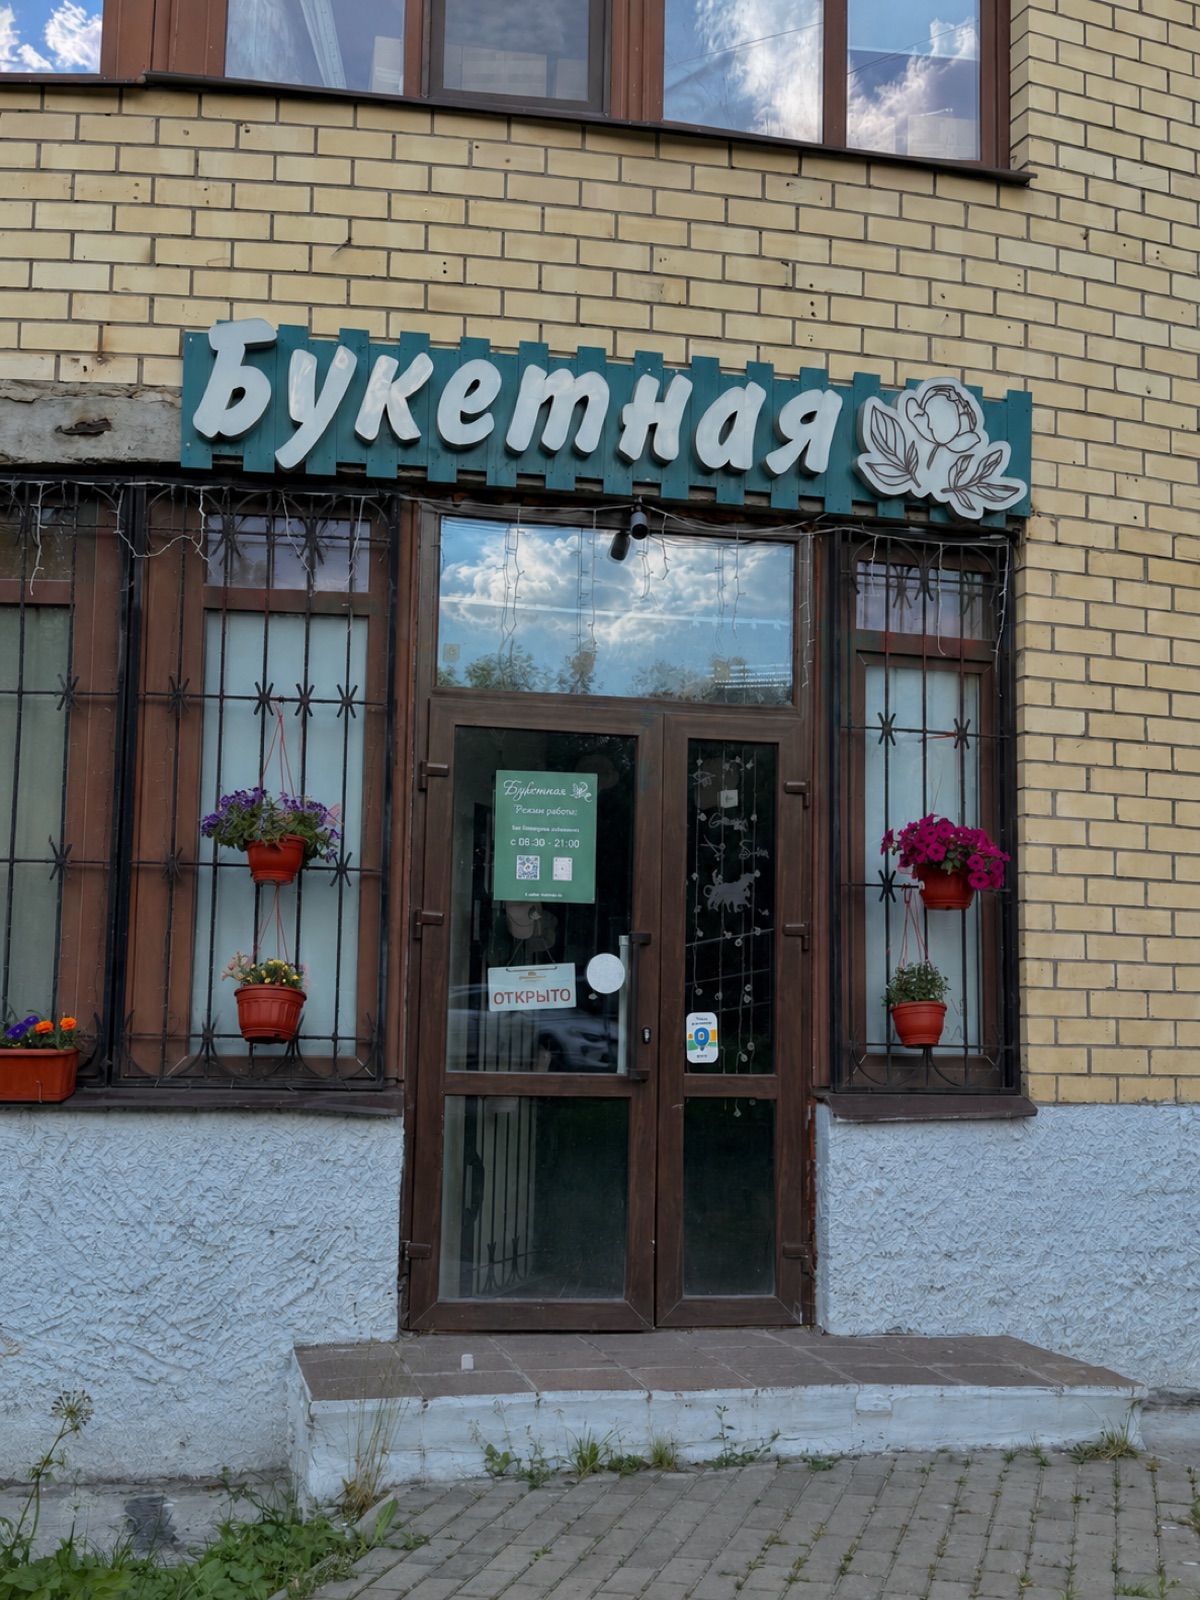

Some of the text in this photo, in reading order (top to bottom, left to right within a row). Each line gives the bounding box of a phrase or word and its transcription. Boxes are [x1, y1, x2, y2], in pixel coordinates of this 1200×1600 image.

[192, 317, 844, 475] Букетная
[503, 779, 567, 801] Букетная
[554, 838, 580, 848] 21:00
[493, 988, 571, 1005] ОТКРЫТО
